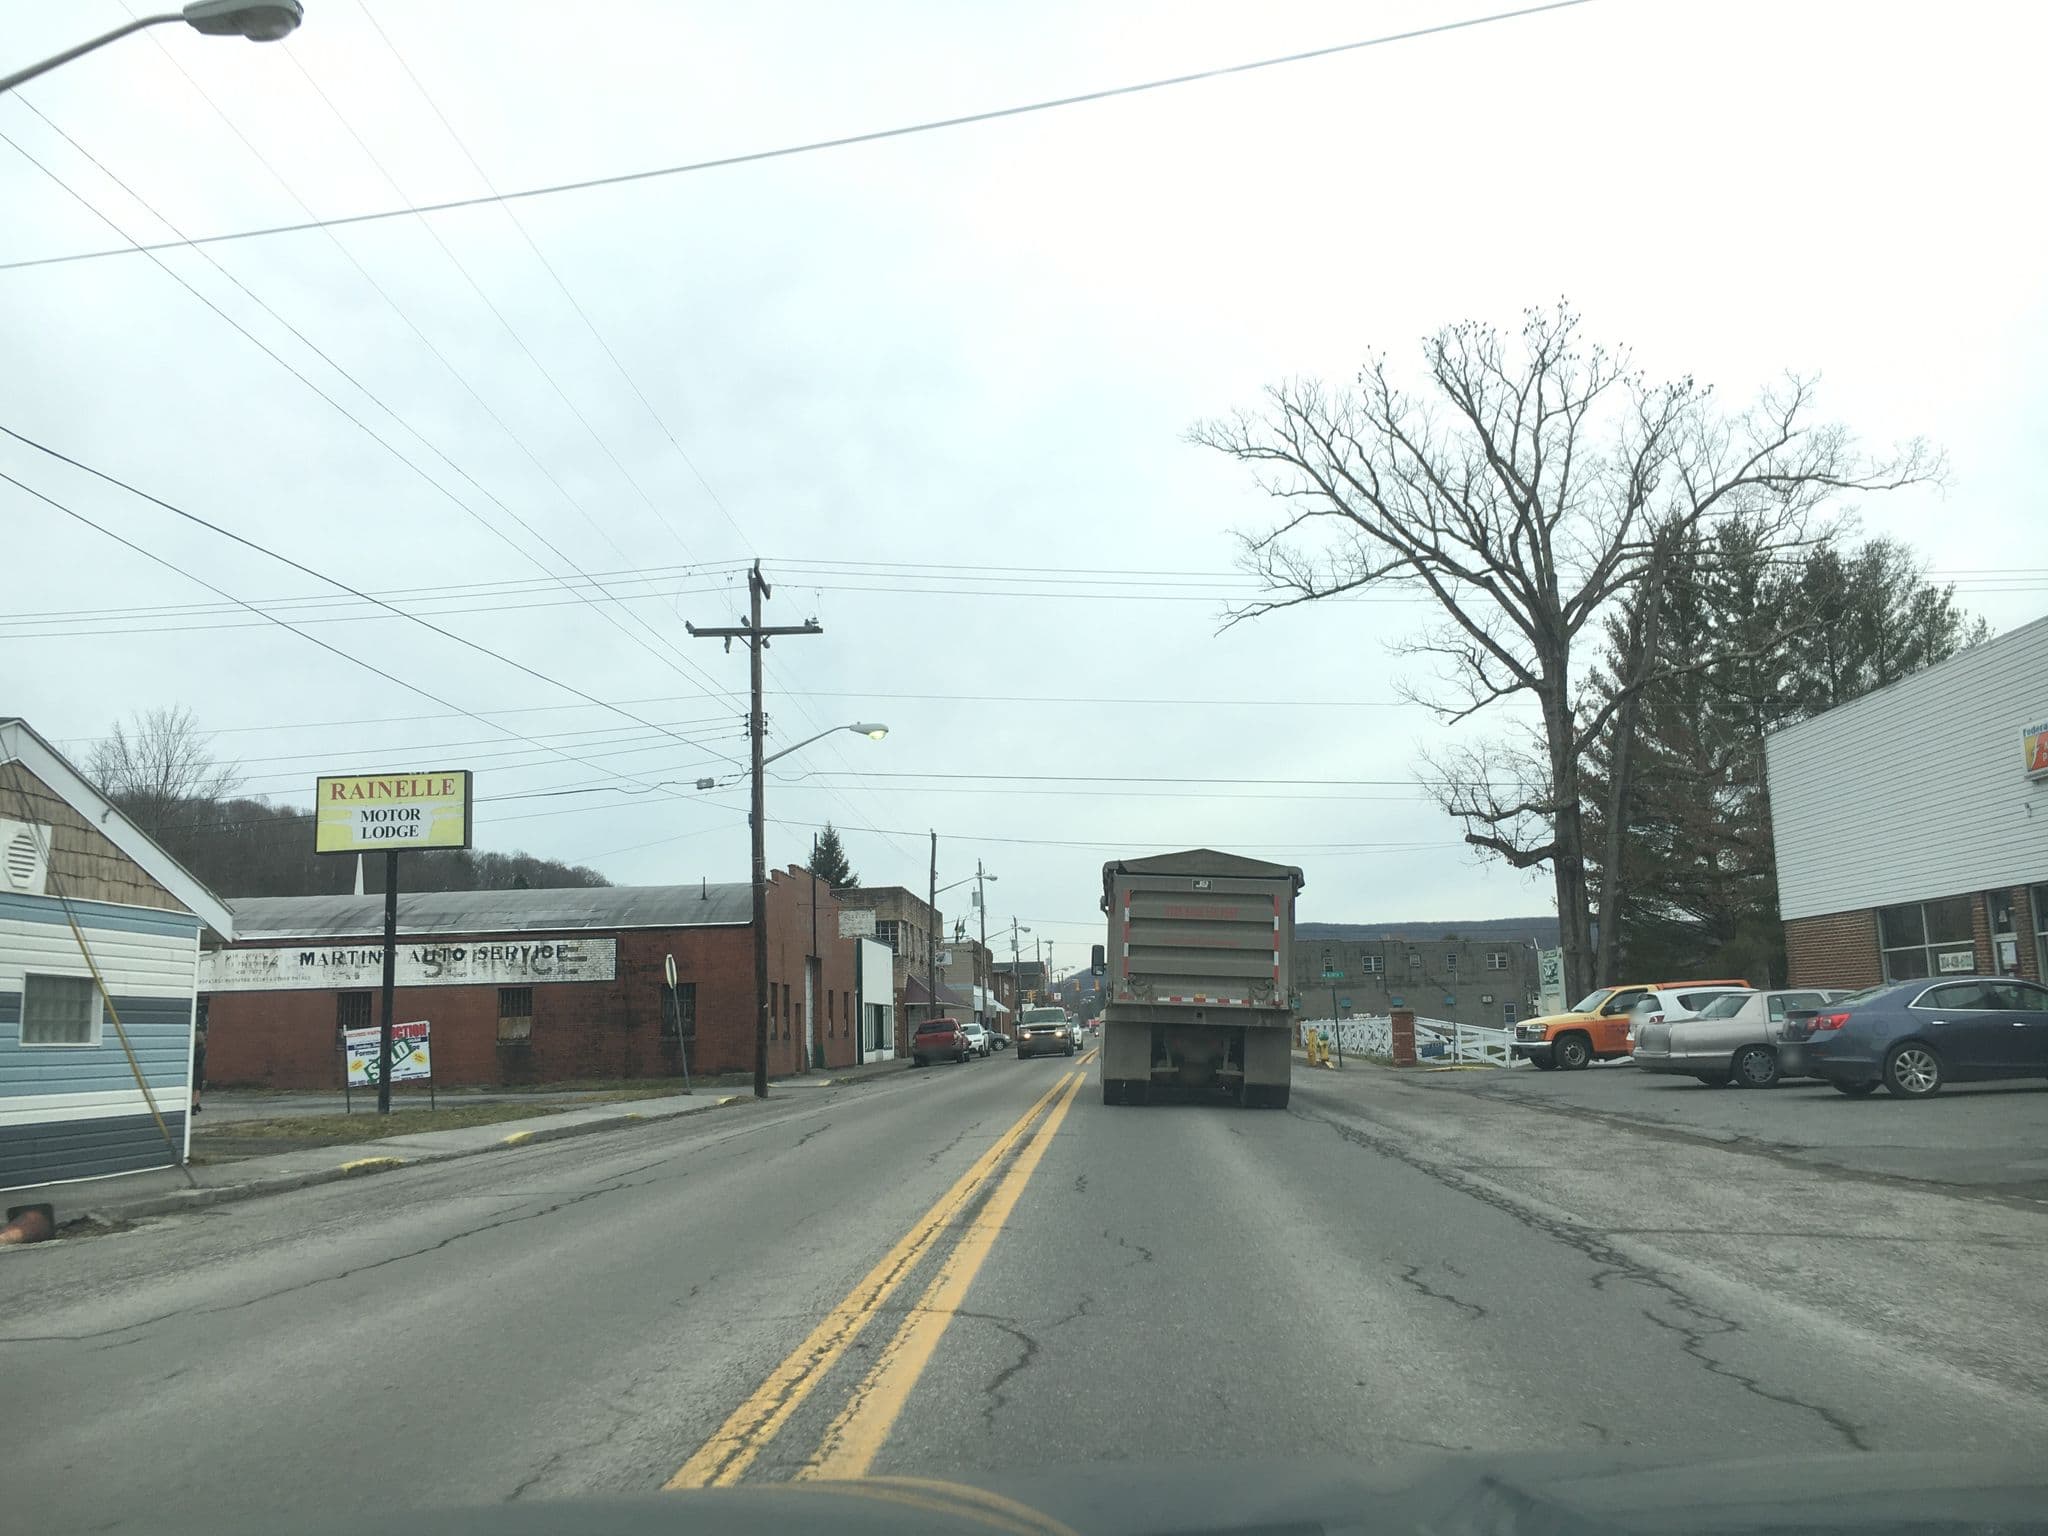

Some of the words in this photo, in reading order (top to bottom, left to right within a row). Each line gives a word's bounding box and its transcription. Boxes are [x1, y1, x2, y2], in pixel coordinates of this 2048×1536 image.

[331, 778, 455, 801] RAINELLE
[360, 808, 421, 823] MOTOR
[361, 825, 419, 840] LODGE
[408, 948, 468, 963] AUTO
[478, 945, 569, 961] SERVICE
[368, 1041, 409, 1080] SLD
